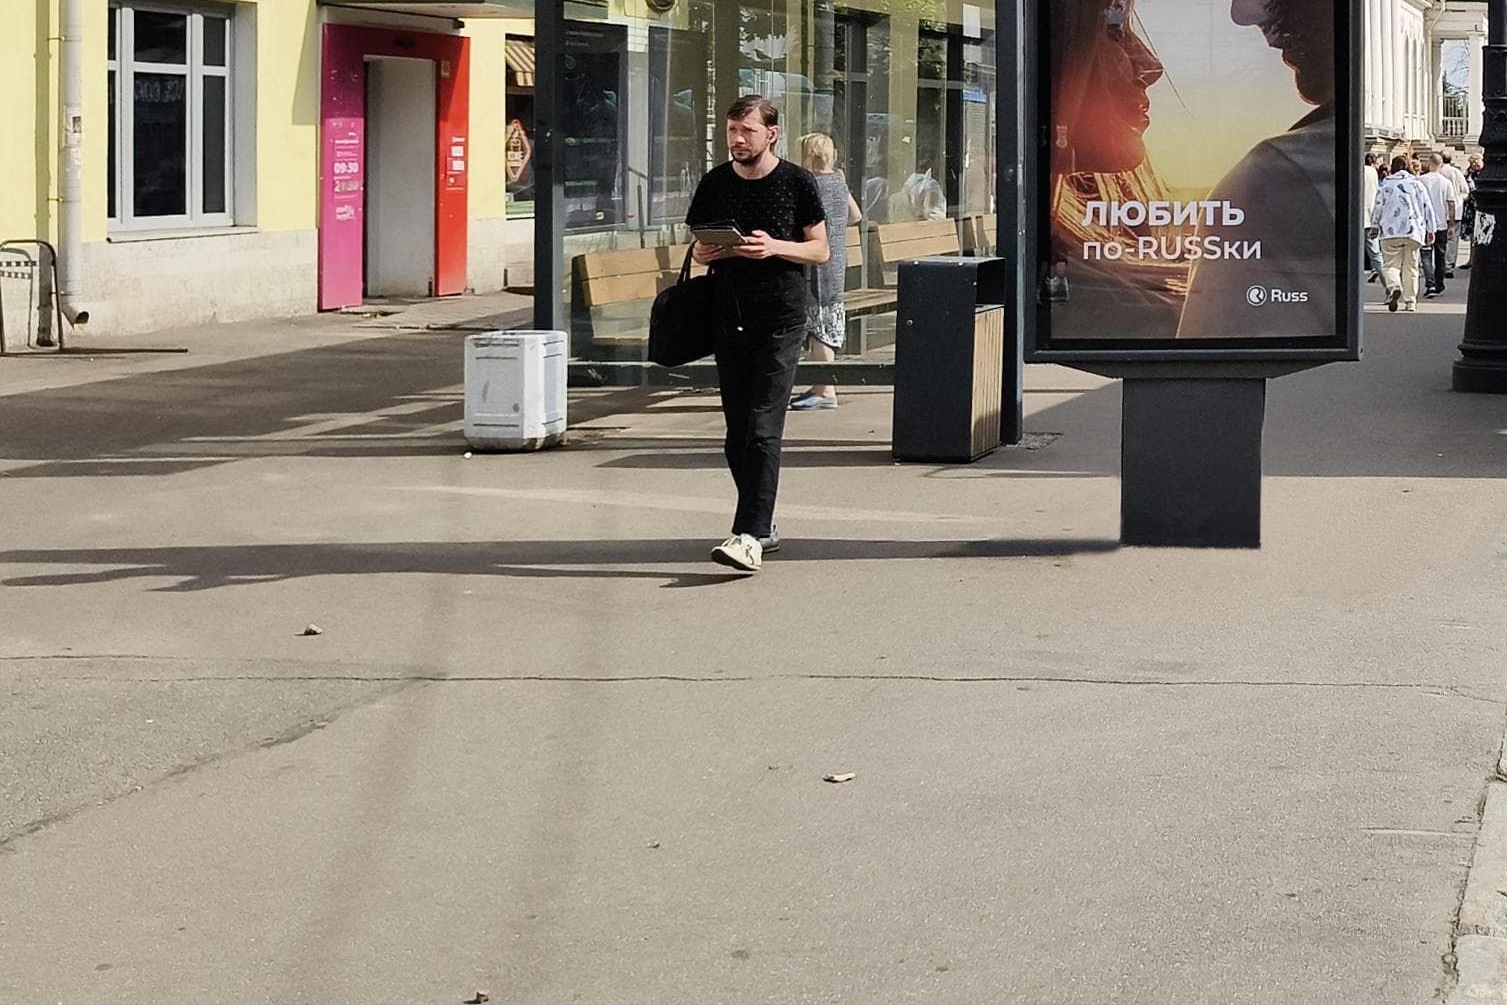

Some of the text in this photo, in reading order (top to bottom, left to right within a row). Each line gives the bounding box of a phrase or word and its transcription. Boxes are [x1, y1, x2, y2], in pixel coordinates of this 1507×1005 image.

[1081, 200, 1246, 227] ЛЮБИТЬ
[1082, 235, 1263, 261] по-RUSSки
[1271, 288, 1309, 303] Russ
